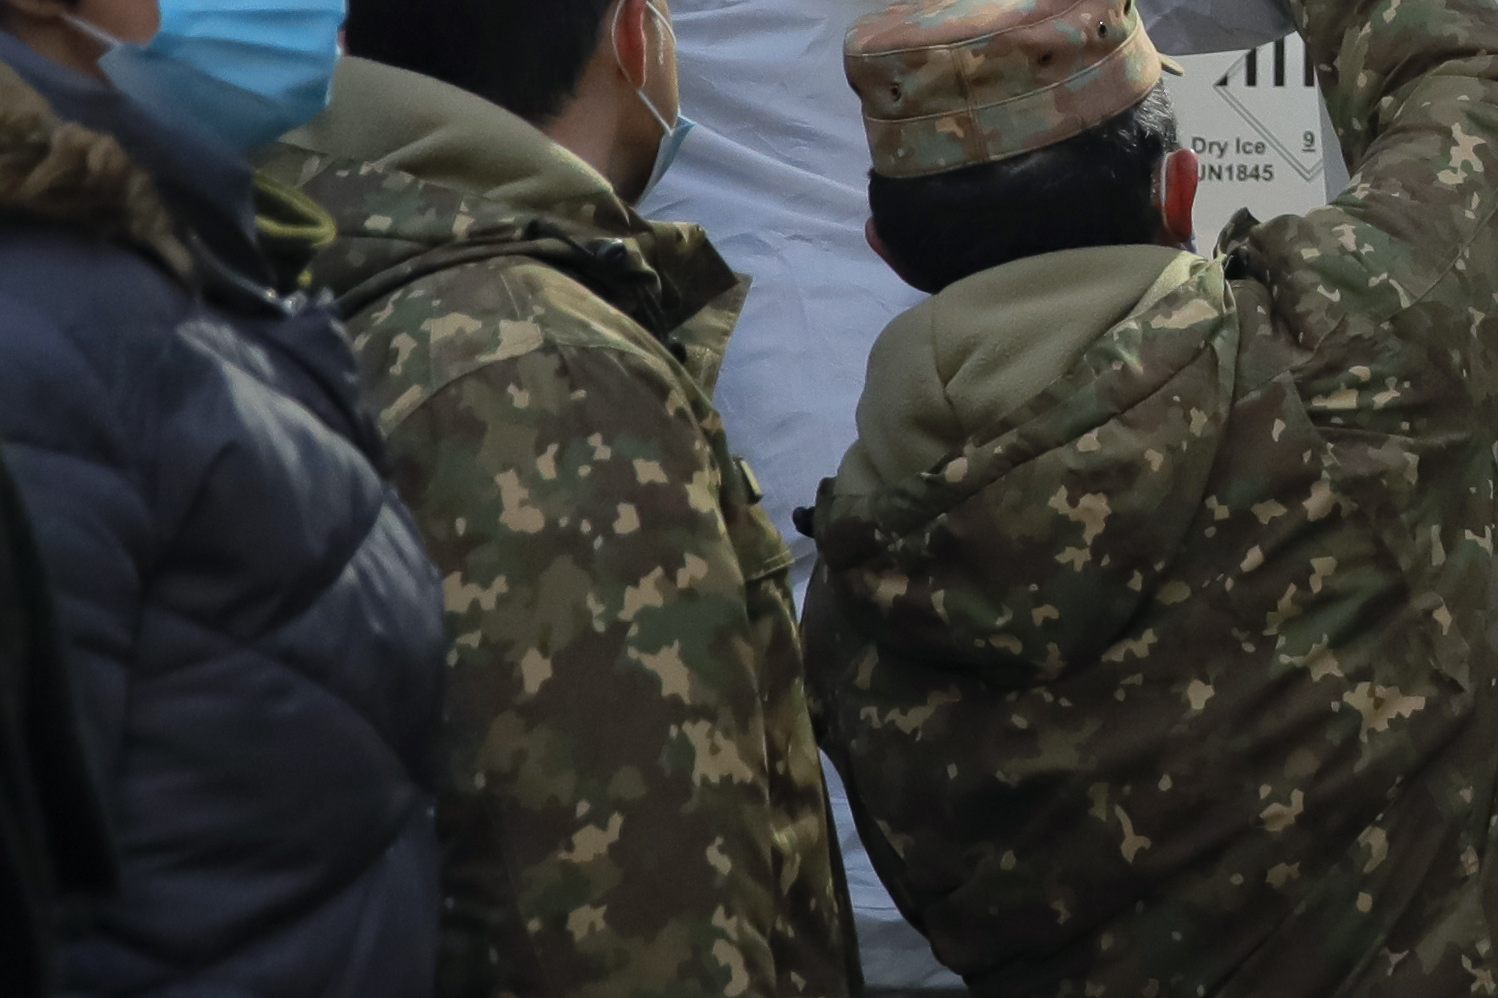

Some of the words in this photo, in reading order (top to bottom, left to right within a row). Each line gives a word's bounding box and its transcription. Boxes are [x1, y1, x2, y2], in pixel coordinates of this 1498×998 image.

[1192, 137, 1228, 158] Dry
[1236, 137, 1266, 155] Ice
[1303, 130, 1315, 149] 9
